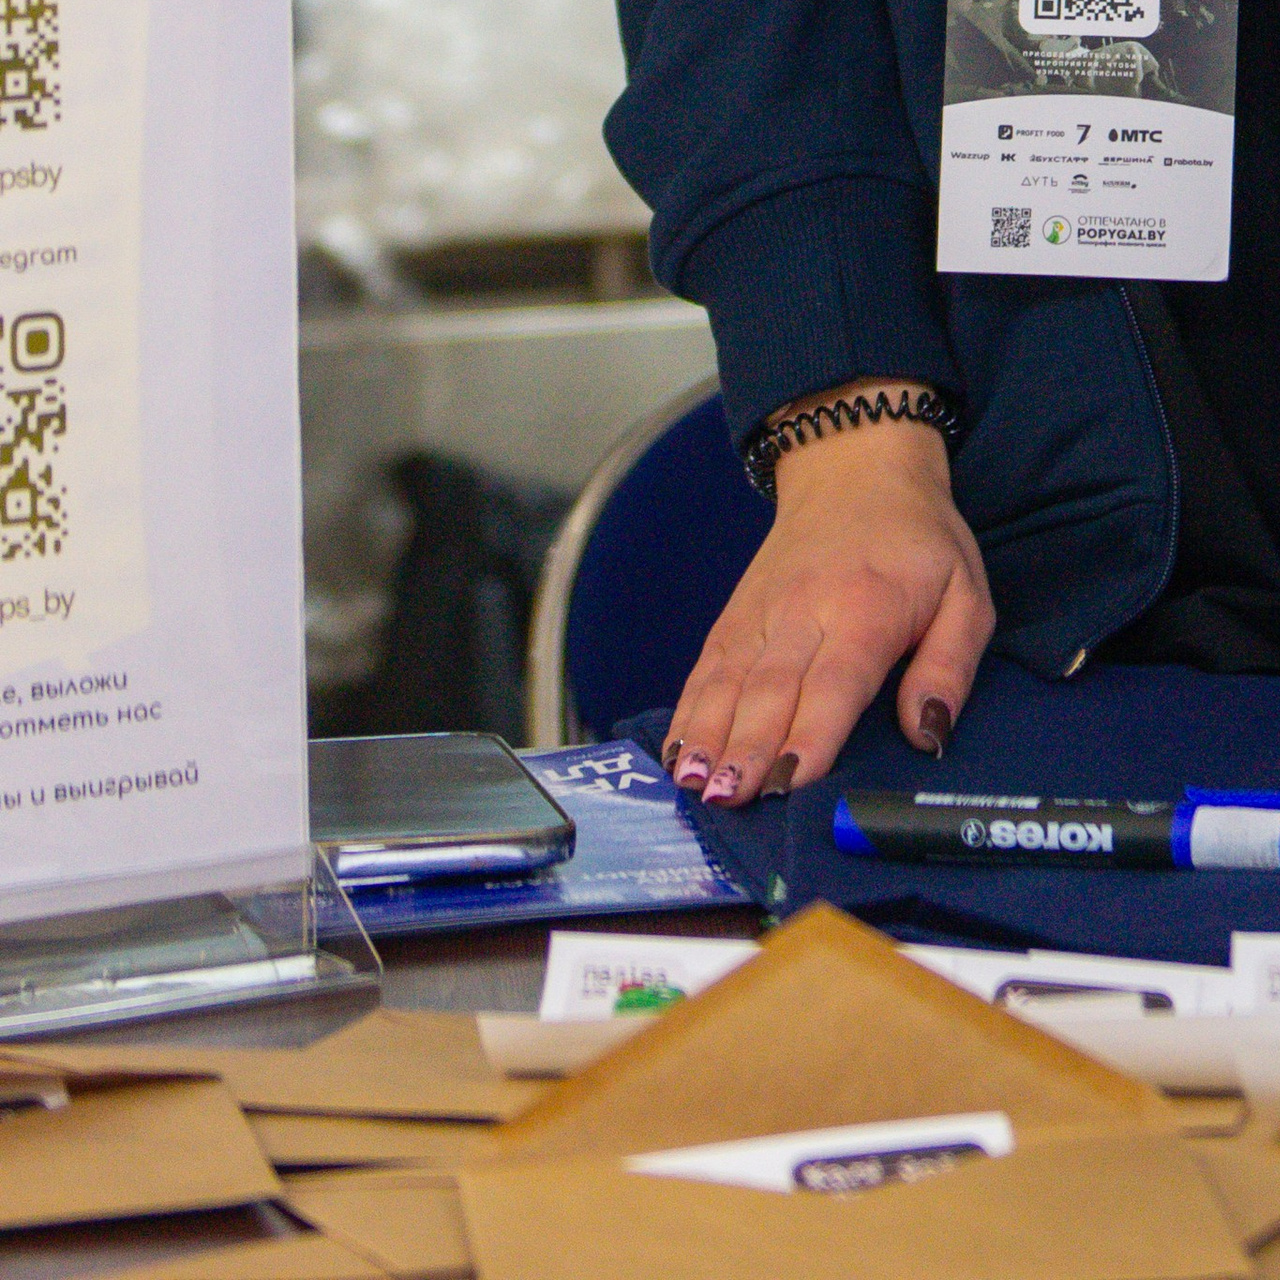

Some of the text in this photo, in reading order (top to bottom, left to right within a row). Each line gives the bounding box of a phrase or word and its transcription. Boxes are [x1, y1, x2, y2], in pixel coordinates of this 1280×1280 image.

[951, 151, 991, 161] Wazzup
[1173, 158, 1214, 167] rabota.by
[1077, 215, 1157, 228] ОТПЕЧАТАНО
[1077, 227, 1167, 241] POPYGAI.BY
[31, 671, 129, 702] выложи
[117, 700, 163, 724] нас
[30, 785, 46, 807] и
[54, 759, 200, 804] выигрывай
